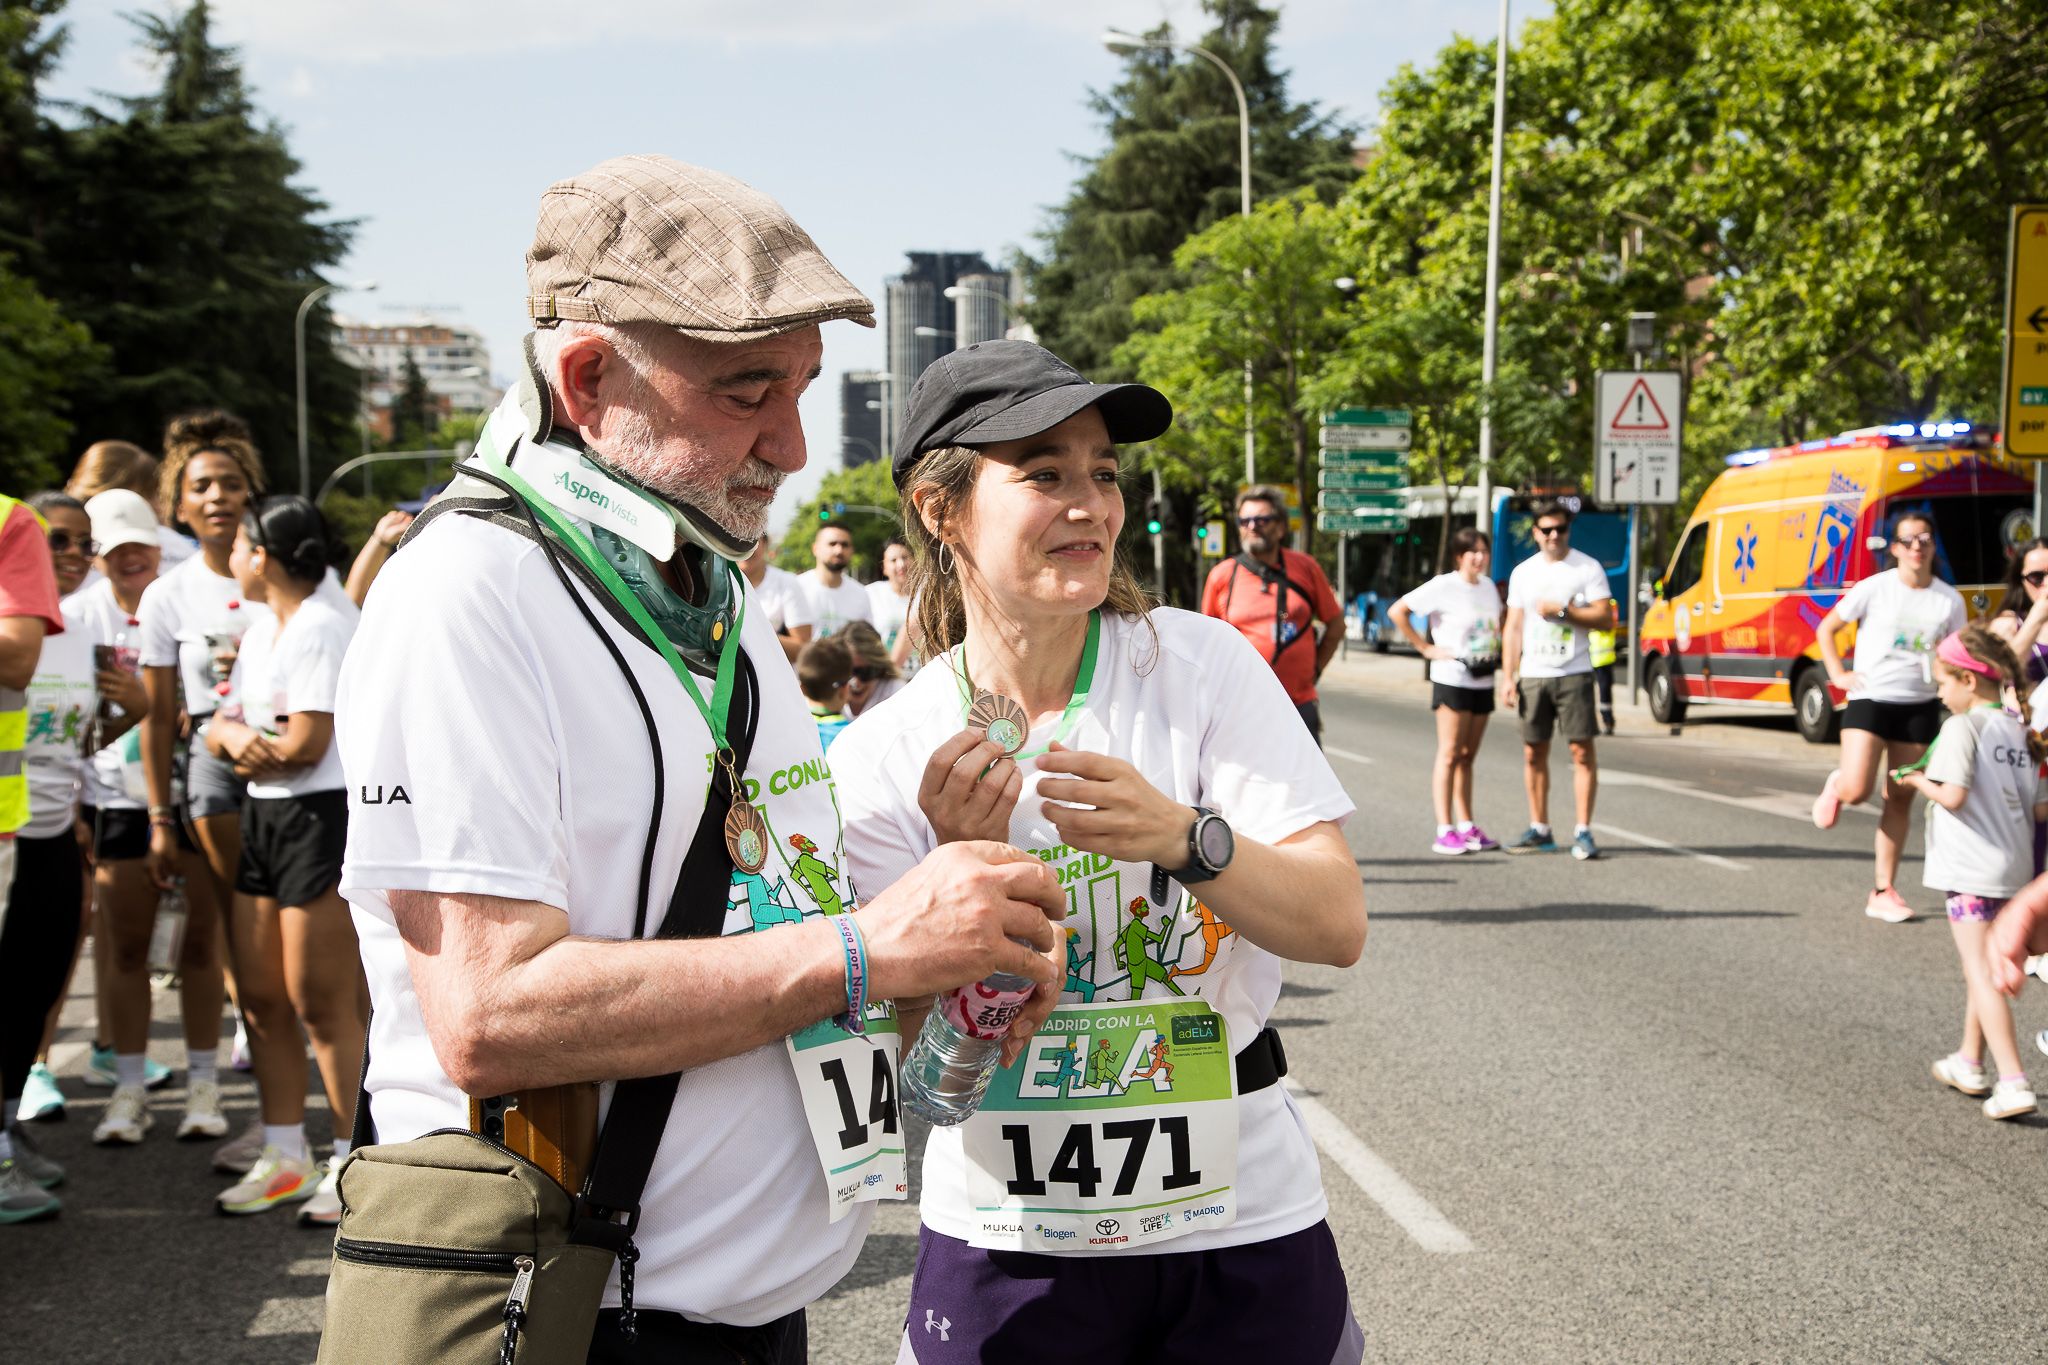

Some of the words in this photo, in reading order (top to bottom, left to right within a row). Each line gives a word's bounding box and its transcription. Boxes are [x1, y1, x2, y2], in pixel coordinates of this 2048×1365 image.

[554, 472, 609, 509] Aspen
[611, 500, 638, 527] Vista
[847, 948, 859, 970] por
[1095, 1015, 1130, 1030] CON
[1135, 1013, 1156, 1026] LA
[1178, 1027, 1214, 1039] adELA
[1017, 1027, 1174, 1100] ELA
[820, 1048, 903, 1150] 14
[1002, 1116, 1201, 1198] 1471
[1139, 1213, 1164, 1226] SPORT
[1193, 1205, 1225, 1218] MADRID
[983, 1223, 1024, 1233] MUKUA
[1143, 1221, 1162, 1233] LIFE
